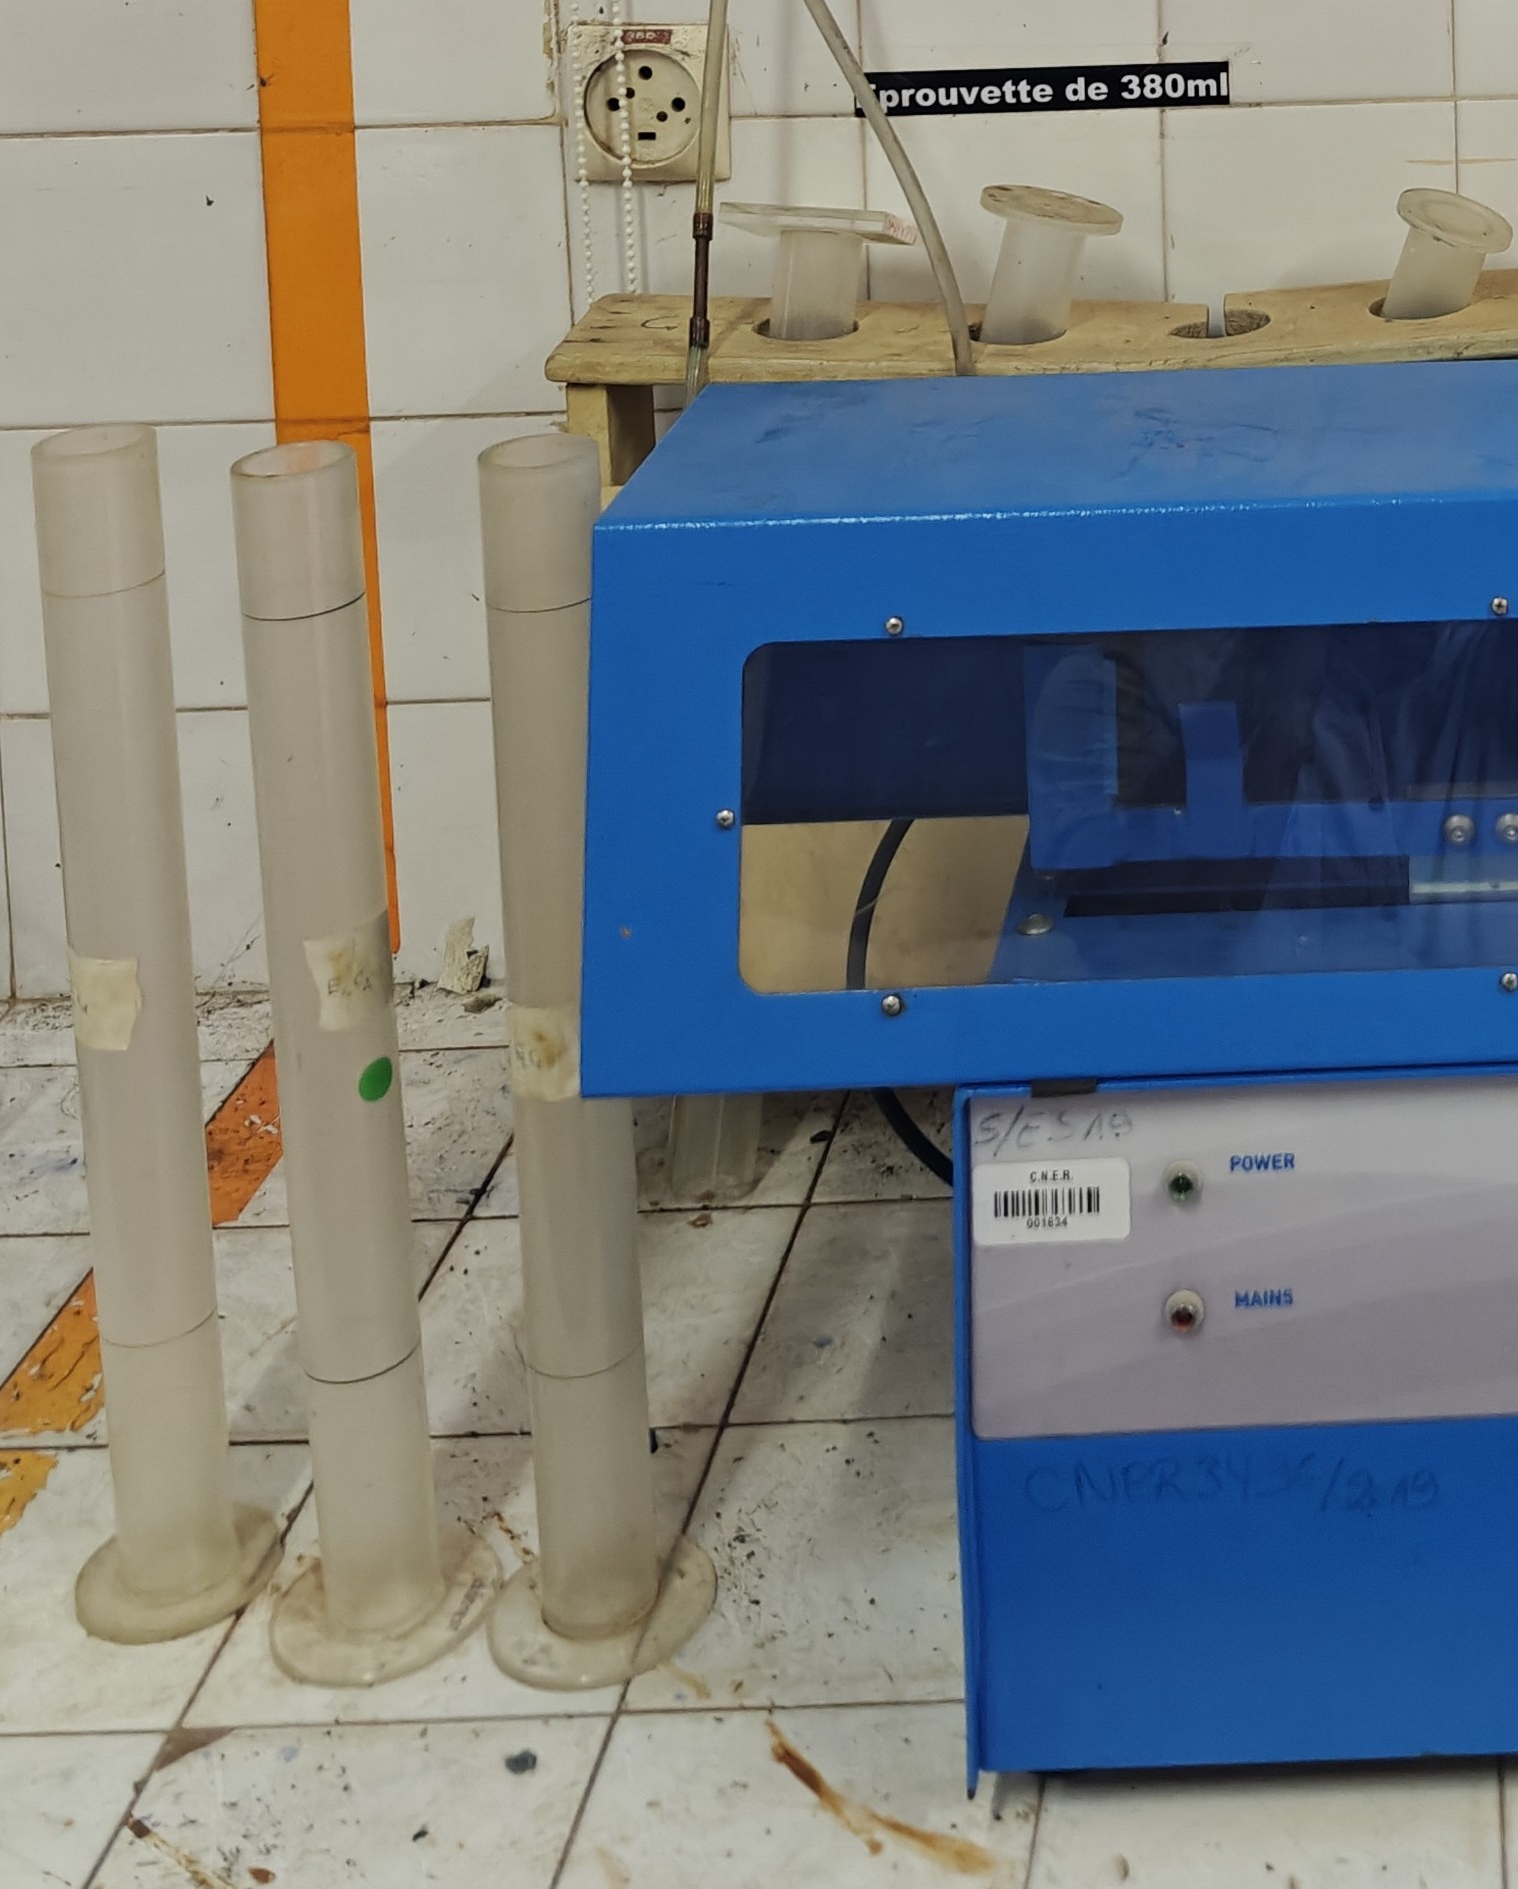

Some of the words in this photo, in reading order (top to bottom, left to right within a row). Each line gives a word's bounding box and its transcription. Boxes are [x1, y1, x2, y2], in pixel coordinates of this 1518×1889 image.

[855, 79, 1054, 114] prouvette
[1065, 77, 1109, 102] de
[1121, 72, 1229, 100] 380ml
[1229, 1153, 1296, 1173] POWER
[1235, 1289, 1294, 1308] MAINS
